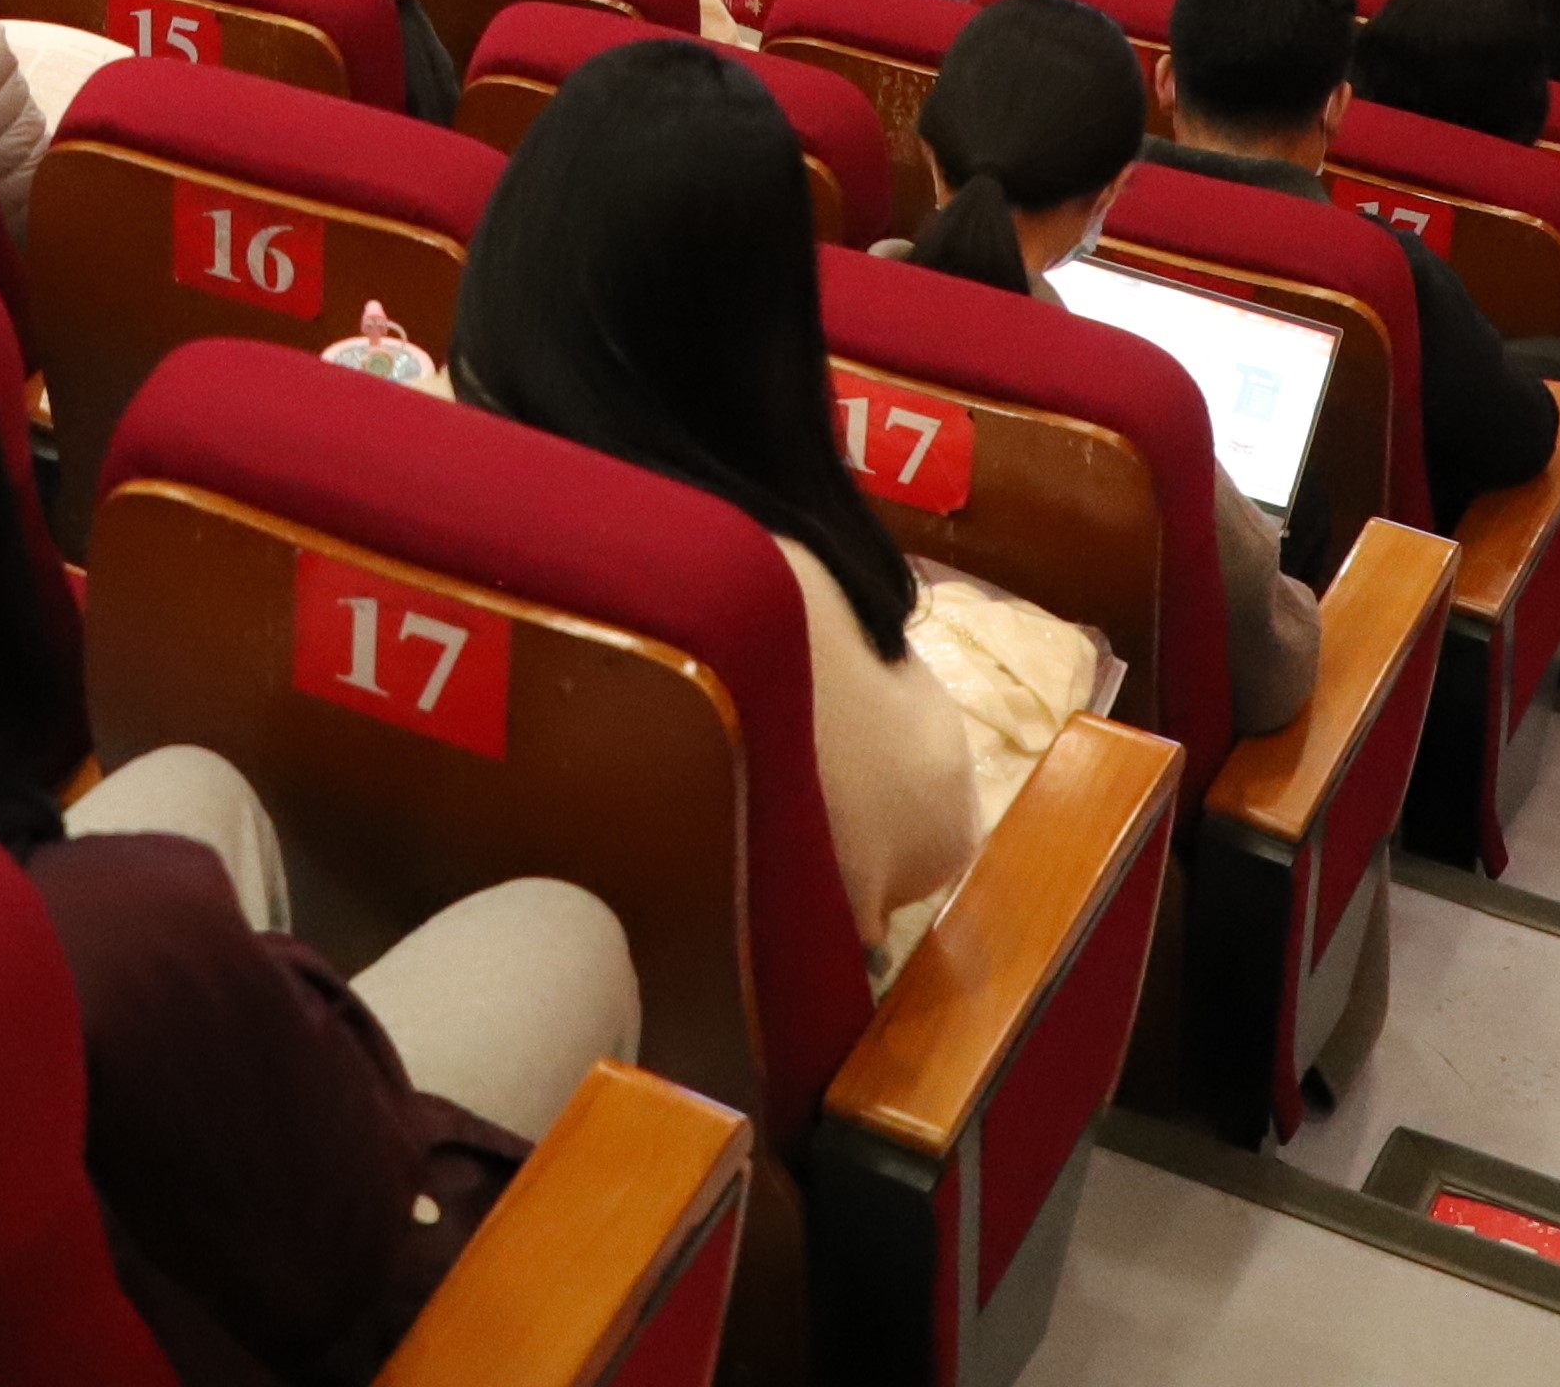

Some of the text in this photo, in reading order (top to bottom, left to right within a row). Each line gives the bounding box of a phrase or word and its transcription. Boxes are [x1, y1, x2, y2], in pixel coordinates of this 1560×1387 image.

[129, 8, 200, 63] 15
[203, 208, 294, 294] 16
[836, 396, 942, 477] 17
[334, 593, 468, 714] 17
